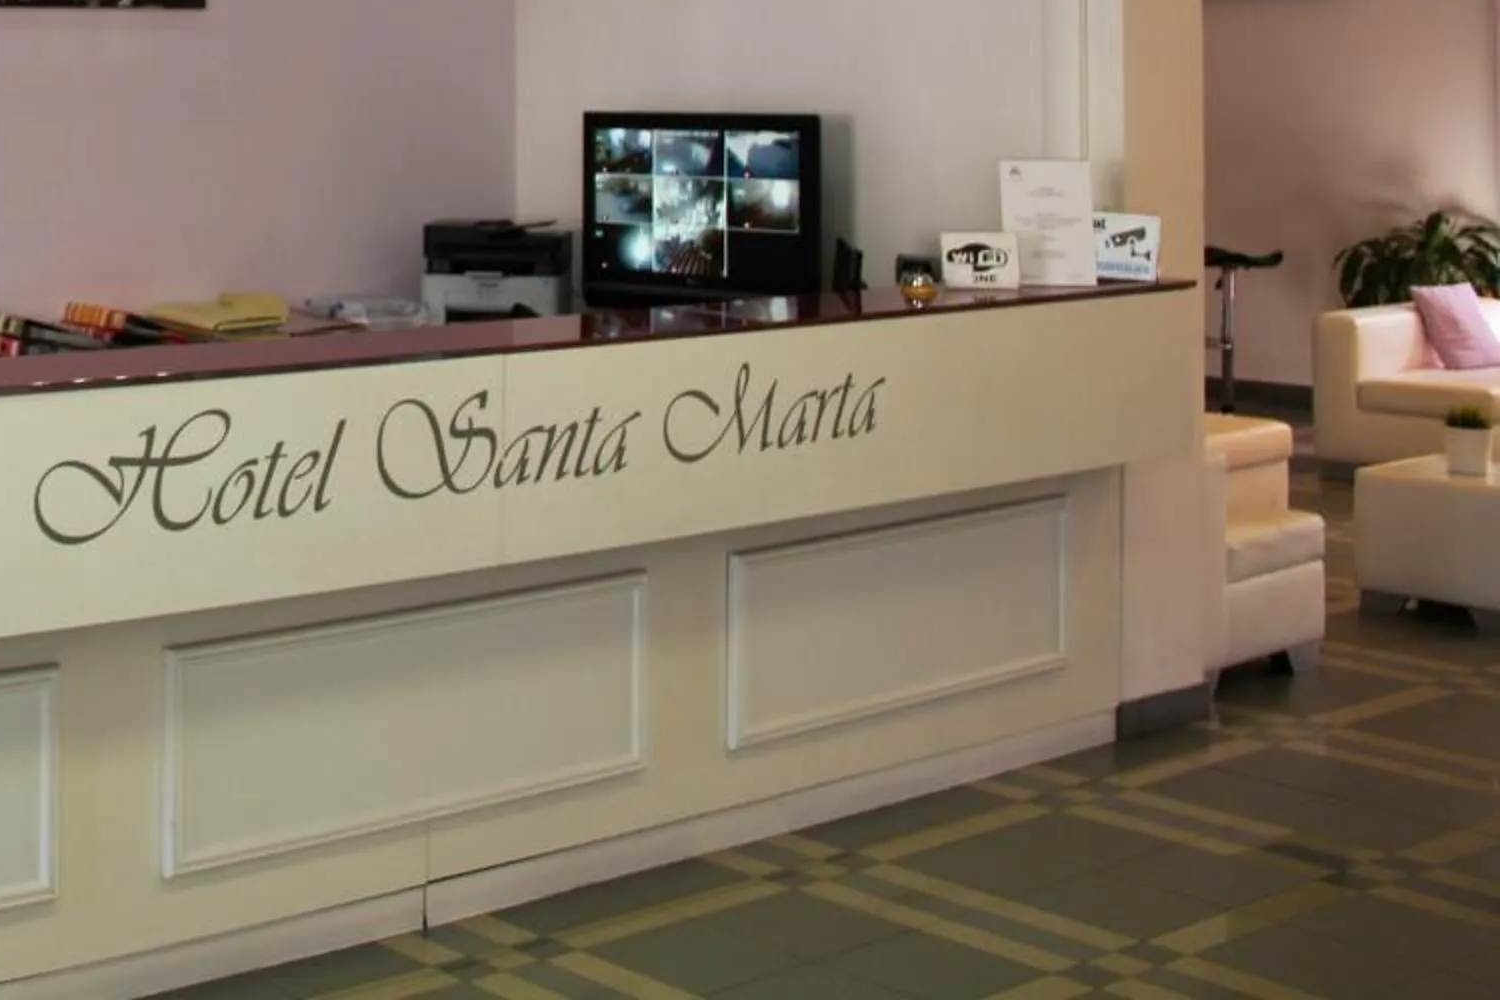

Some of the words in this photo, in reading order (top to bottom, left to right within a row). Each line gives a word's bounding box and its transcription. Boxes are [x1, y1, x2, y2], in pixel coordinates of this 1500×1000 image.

[34, 409, 346, 545] Hotel
[377, 390, 641, 500] Santa
[663, 362, 885, 463] Marta
